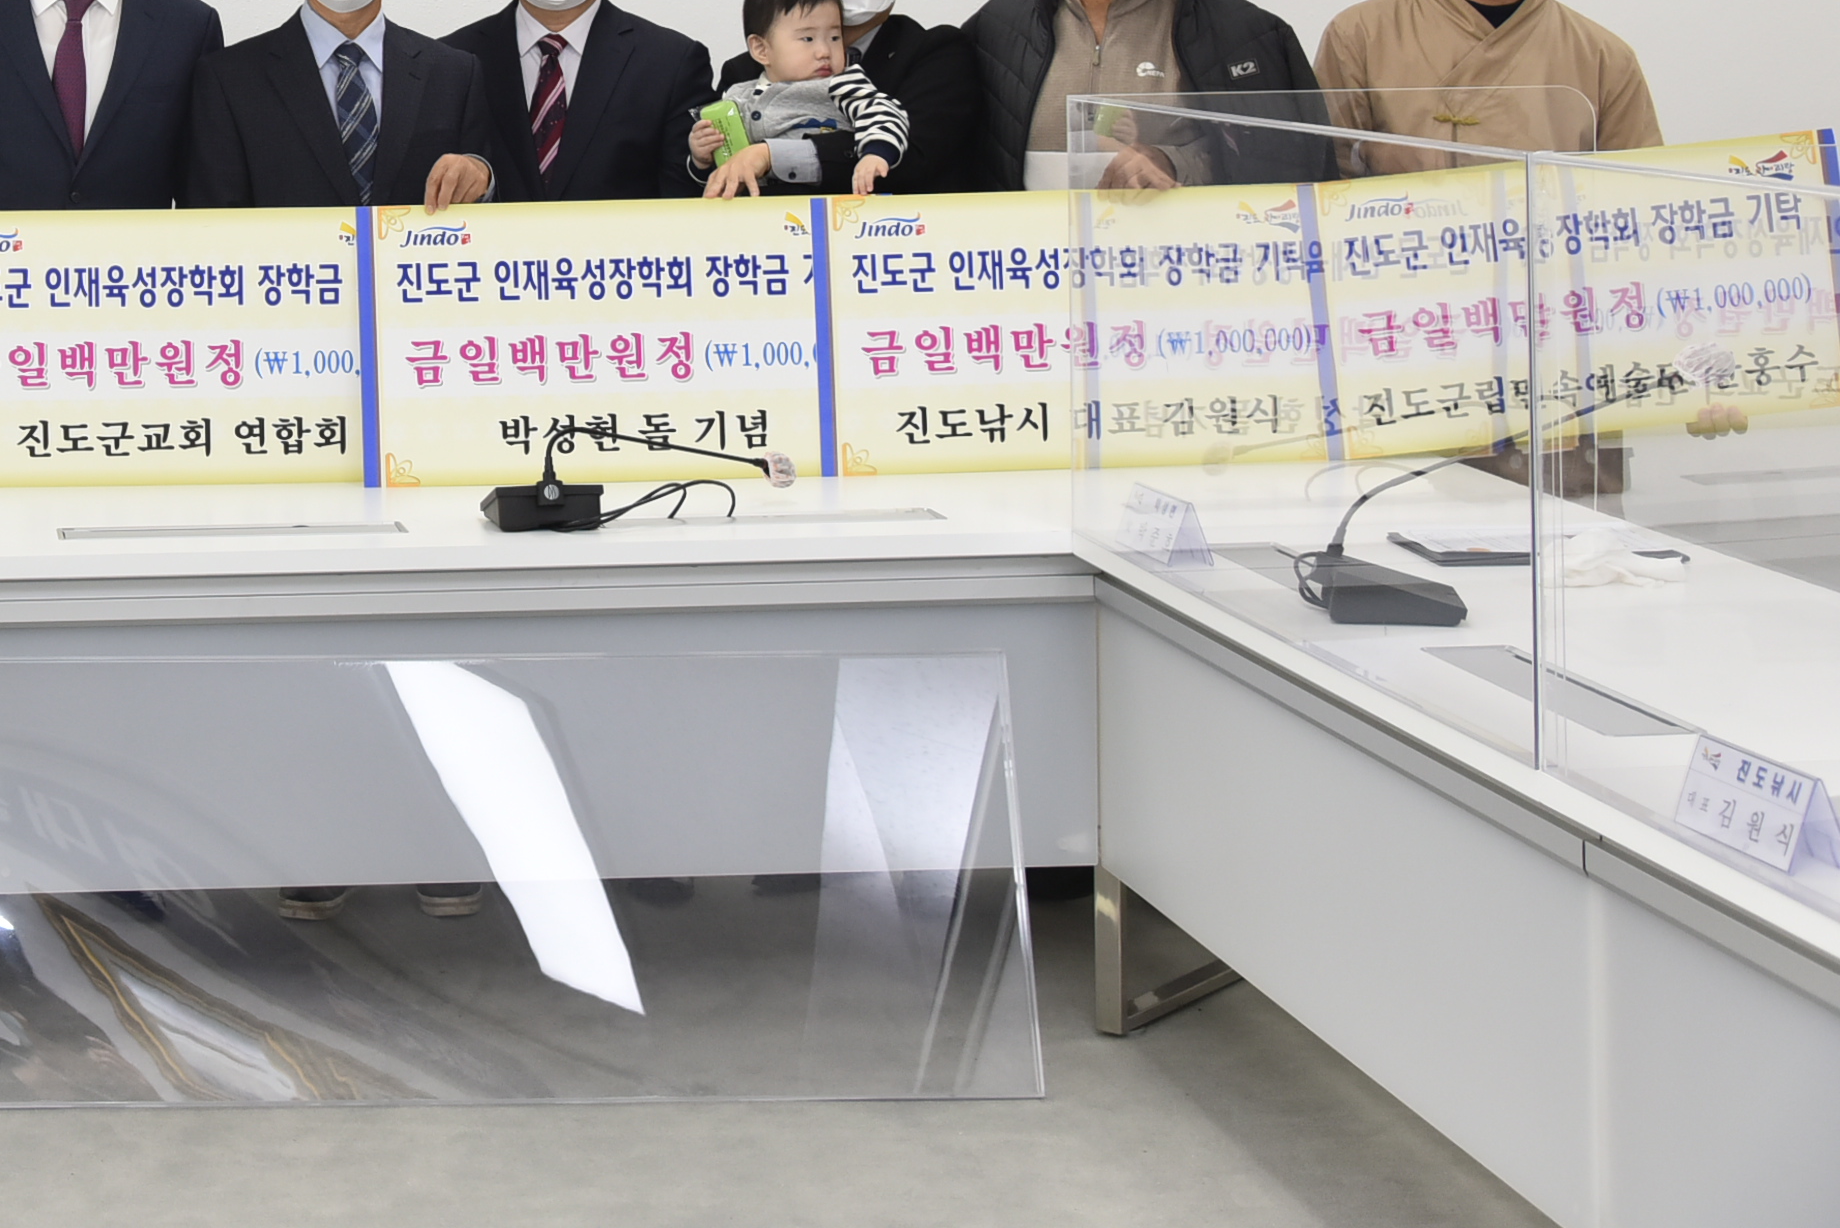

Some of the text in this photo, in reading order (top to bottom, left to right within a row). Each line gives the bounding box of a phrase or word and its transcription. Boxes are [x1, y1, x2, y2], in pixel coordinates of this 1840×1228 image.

[1230, 61, 1257, 78] K2
[855, 219, 914, 239] Jindo
[1344, 231, 1429, 278] 진도군
[1651, 196, 1736, 245] 장학금
[1745, 192, 1803, 233] 기탁
[1345, 202, 1403, 223] Jindo
[400, 229, 460, 247] Jindo
[44, 263, 245, 308] 인재육성장학회
[258, 262, 344, 306] 장학금
[396, 259, 481, 303] 진도군
[494, 256, 692, 300] 인재육성장학회
[705, 253, 790, 297] 장학금
[851, 251, 936, 294] 진도군
[949, 246, 1145, 291] 인재육성장학회
[1158, 242, 1242, 287] 장학금
[405, 330, 695, 386] 금일백만원정
[861, 320, 1145, 377] 금일백만원정
[1716, 343, 1819, 389] 홍수
[16, 415, 348, 458] 진도군교회 연합회
[498, 409, 768, 455] 박성현 돌 기념
[895, 394, 1279, 445] 진도낚시 대표 김원식
[1736, 759, 1803, 806] 진도낚시
[1718, 799, 1795, 857] 김원식
